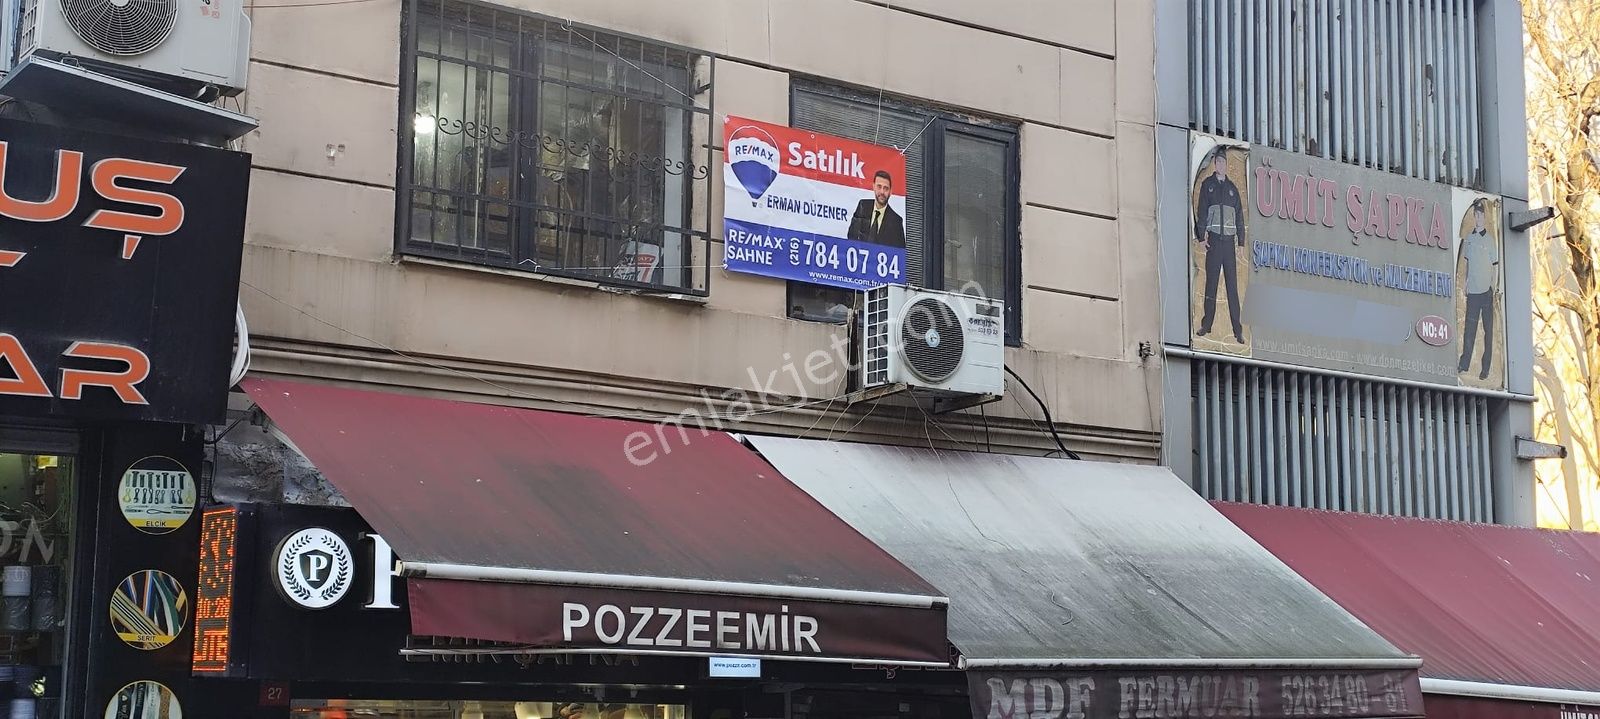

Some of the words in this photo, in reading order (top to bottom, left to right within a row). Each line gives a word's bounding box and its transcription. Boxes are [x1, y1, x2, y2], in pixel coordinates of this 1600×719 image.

[734, 145, 774, 163] RE/MAX
[787, 141, 866, 180] Satılık
[766, 194, 801, 215] ERMAN
[803, 199, 848, 223] DÜZENER
[1255, 156, 1338, 228] ÜMİT
[1346, 184, 1450, 250] ŞAPKA
[728, 229, 783, 250] RE/MAX
[727, 245, 773, 266] SAHNE
[789, 237, 801, 266] (216)
[803, 239, 840, 271] 784
[846, 246, 870, 274] 07
[876, 251, 901, 280] 84
[1253, 239, 1291, 273] ŞAPKA
[1370, 265, 1383, 287] ve
[1384, 263, 1433, 295] MALZEME
[1438, 324, 1449, 340] 41
[306, 554, 328, 582] P
[562, 602, 822, 654] POZZEEMİR
[267, 687, 282, 699] 27
[986, 676, 1096, 719] MDF
[1118, 674, 1261, 719] FERMUAR
